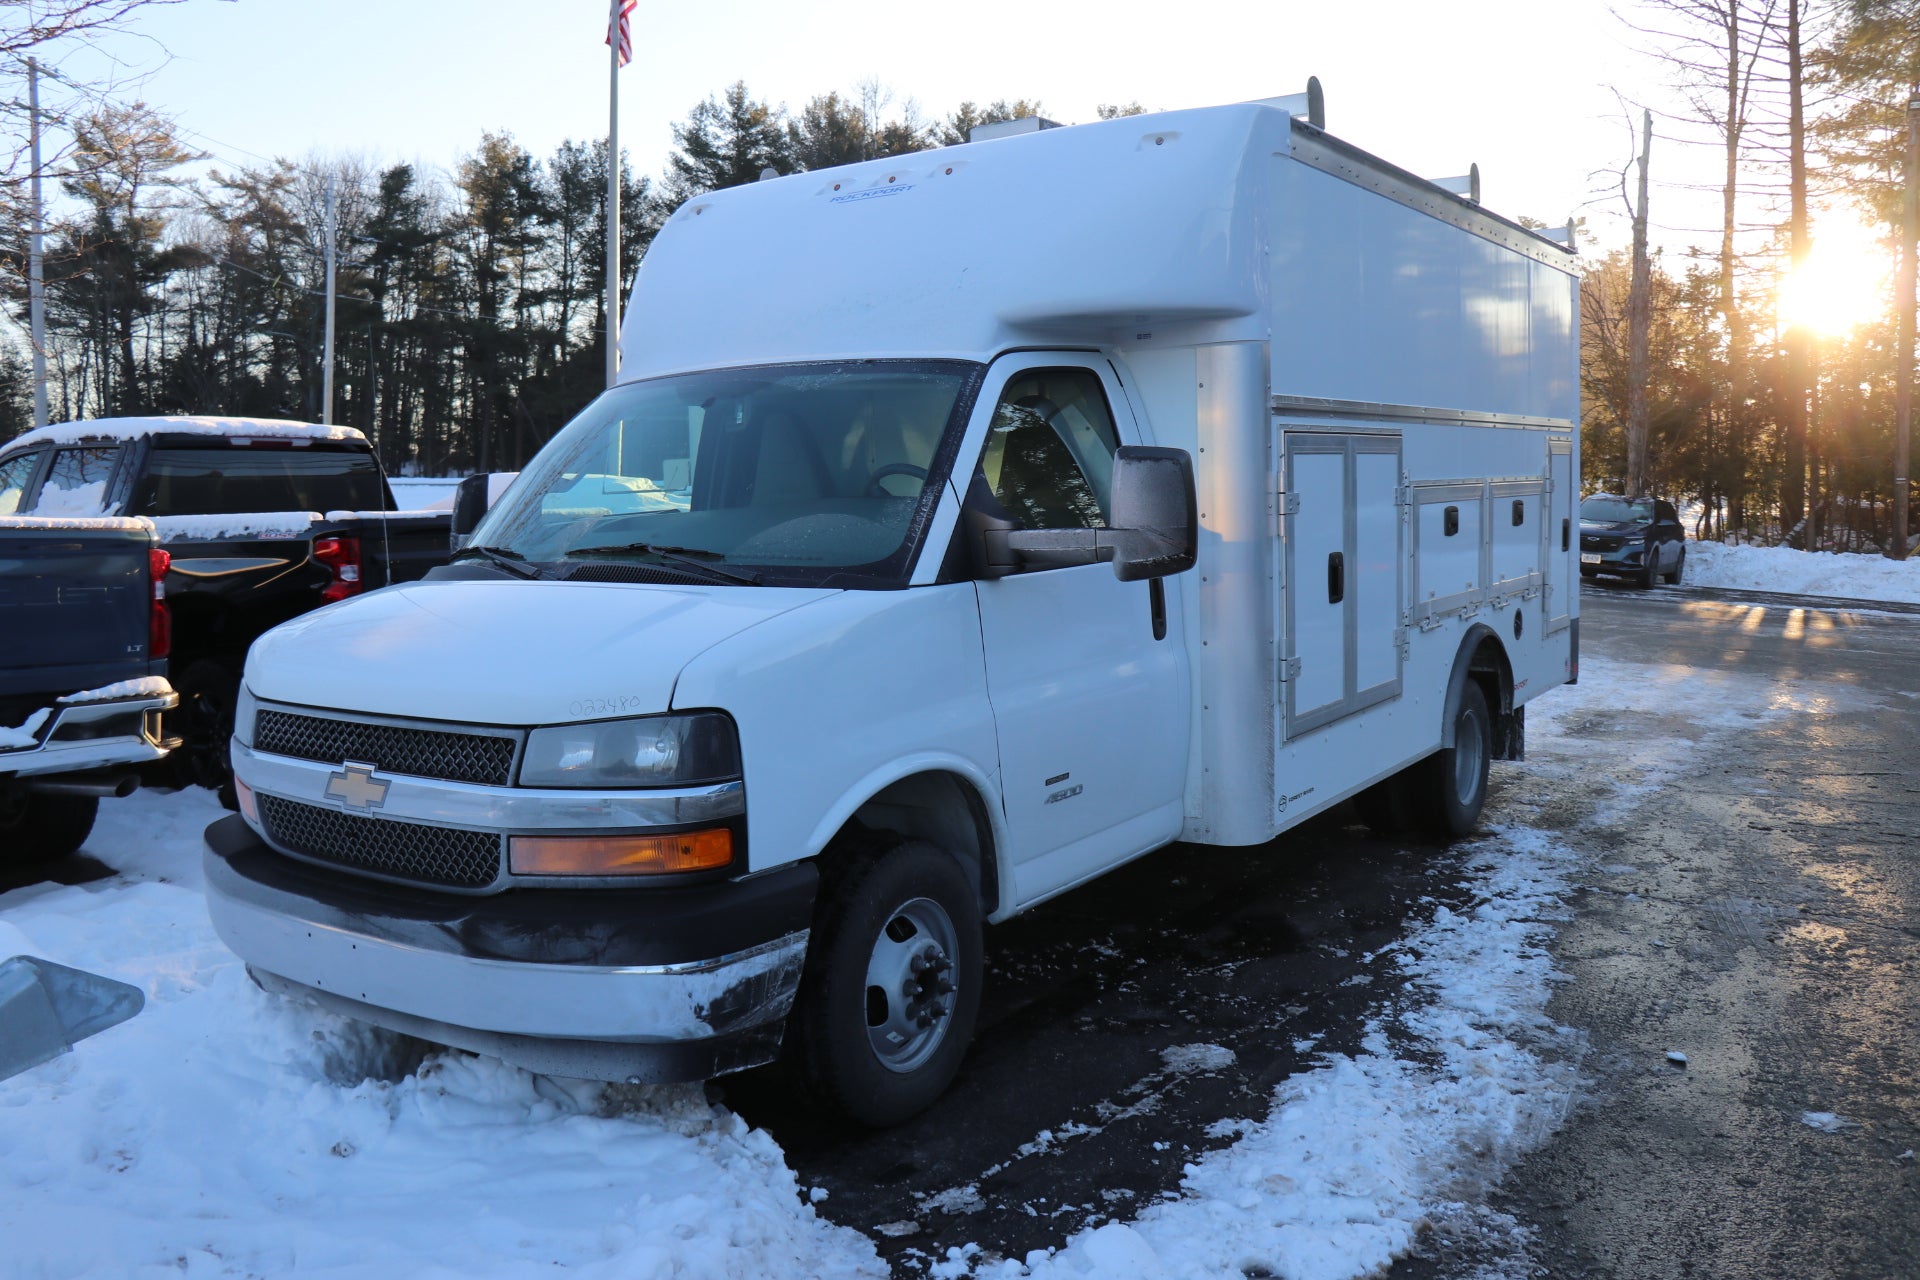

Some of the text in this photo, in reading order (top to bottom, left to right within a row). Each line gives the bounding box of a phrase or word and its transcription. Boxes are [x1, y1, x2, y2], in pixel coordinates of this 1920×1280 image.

[829, 185, 916, 203] ROCKPORT
[127, 644, 143, 652] LT
[569, 696, 641, 717] 022480
